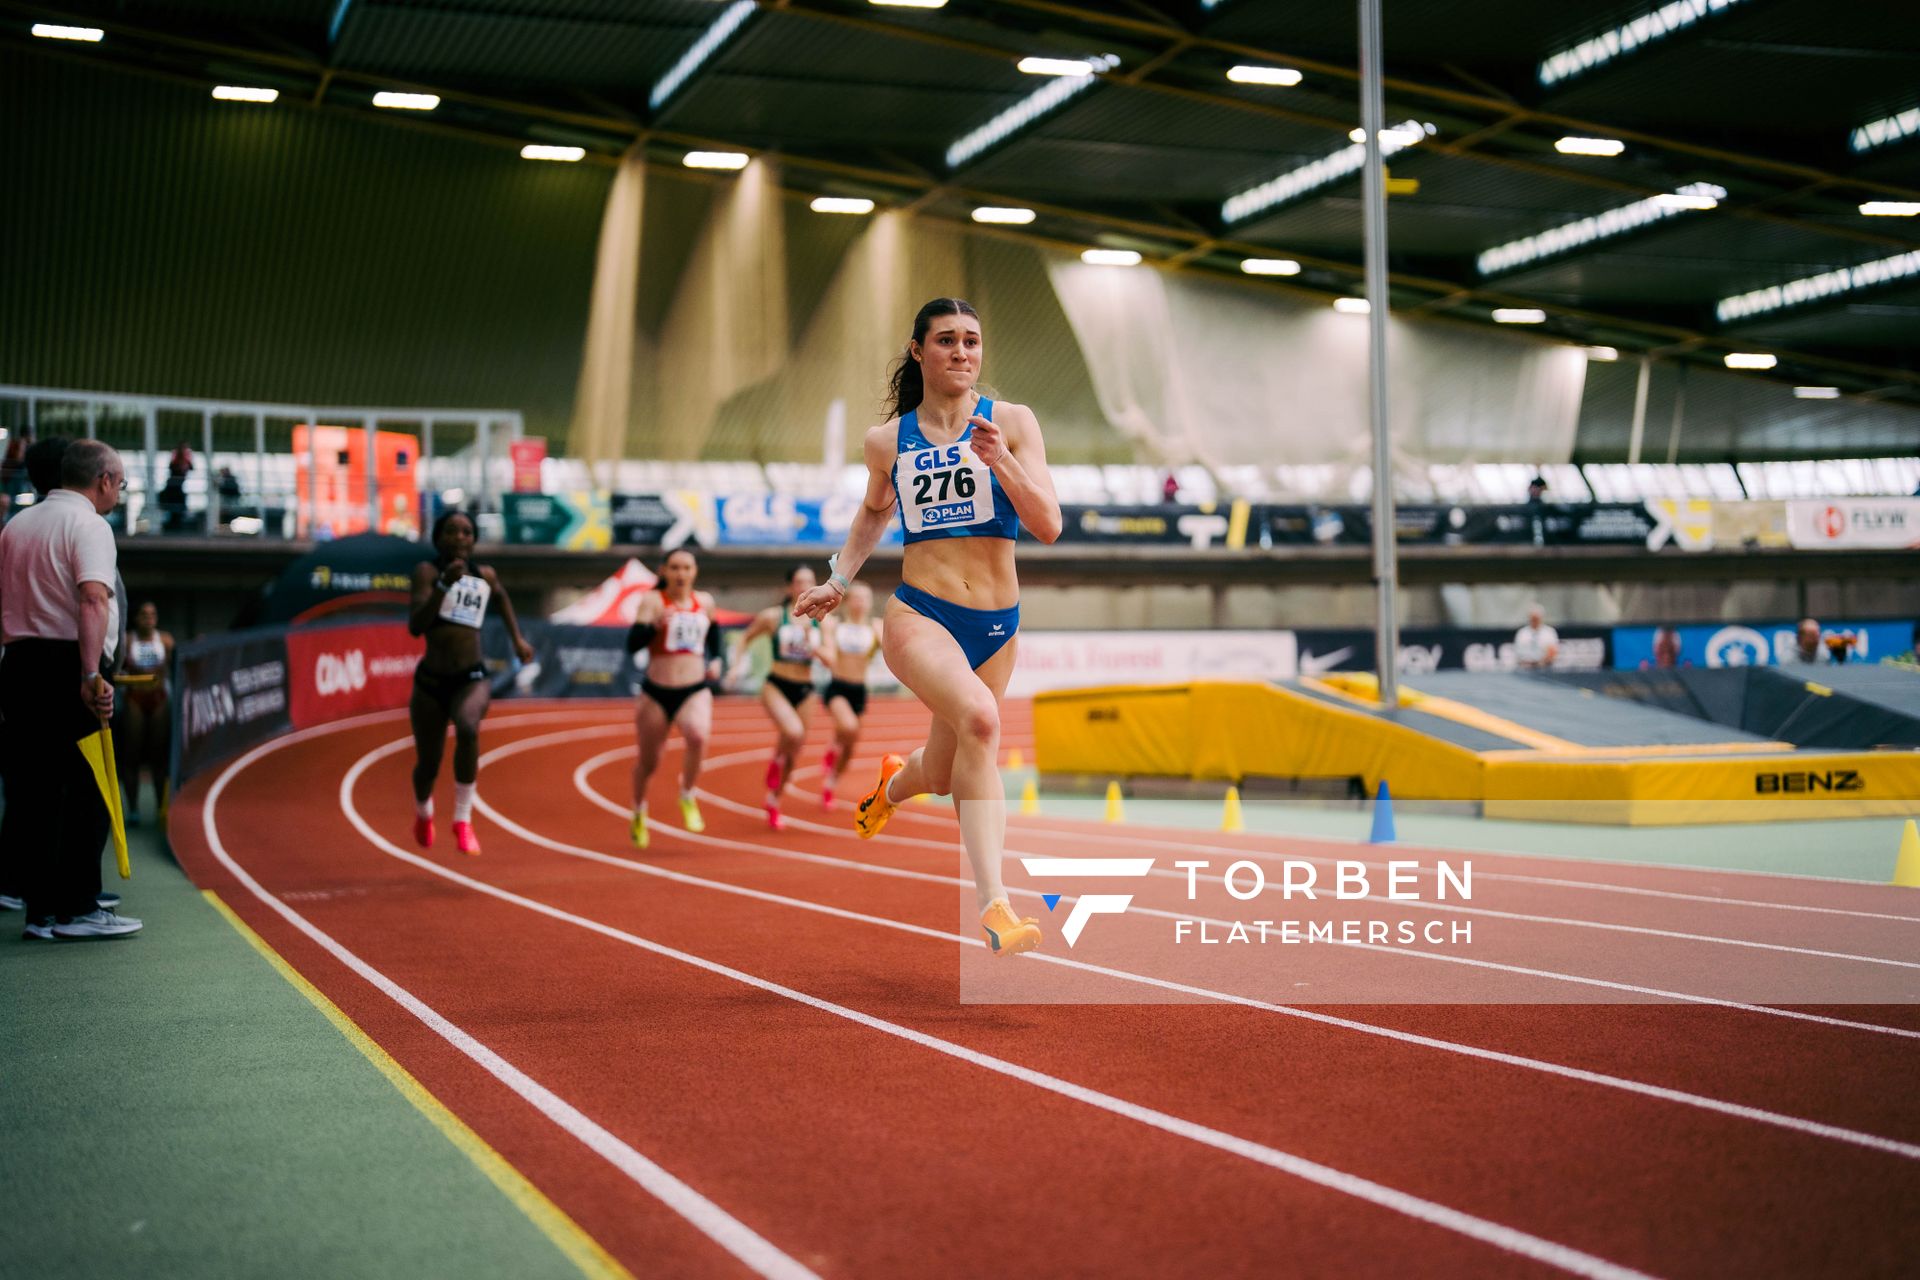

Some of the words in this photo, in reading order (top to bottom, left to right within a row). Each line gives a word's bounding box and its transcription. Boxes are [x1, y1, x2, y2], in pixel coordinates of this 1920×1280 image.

[913, 467, 976, 505] 276
[942, 505, 972, 517] PLAN
[457, 590, 482, 609] 164
[1755, 771, 1859, 793] BENZ
